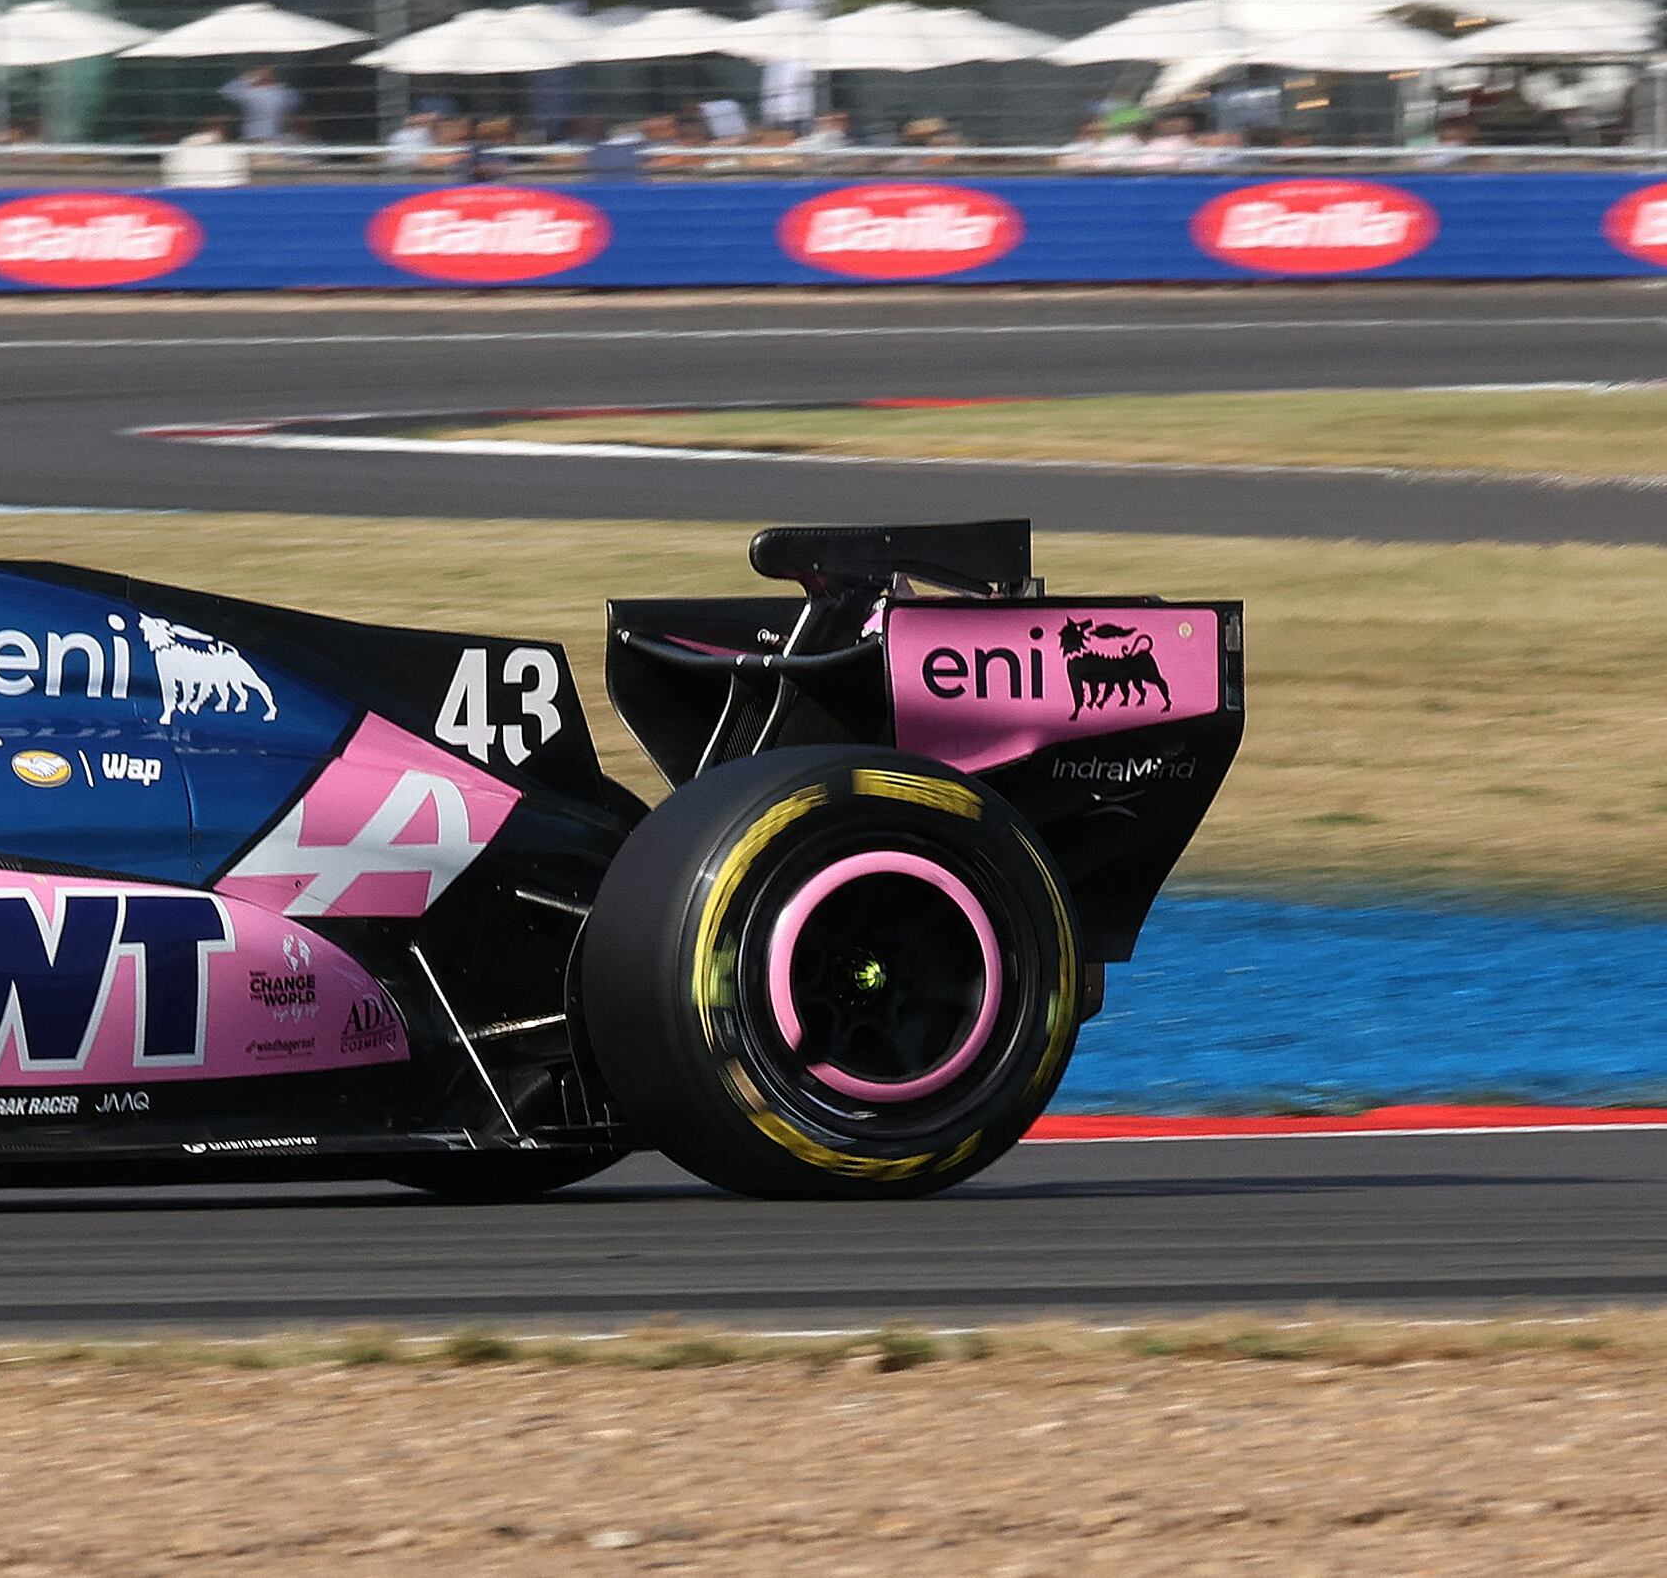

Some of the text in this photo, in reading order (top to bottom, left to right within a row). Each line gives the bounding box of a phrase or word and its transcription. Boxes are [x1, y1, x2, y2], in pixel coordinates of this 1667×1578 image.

[922, 628, 1045, 700] eni
[433, 647, 562, 767] 43
[101, 753, 162, 787] Wap
[249, 974, 316, 993] CHANGE
[264, 990, 316, 1007] WORLD
[28, 1094, 80, 1115] RACER
